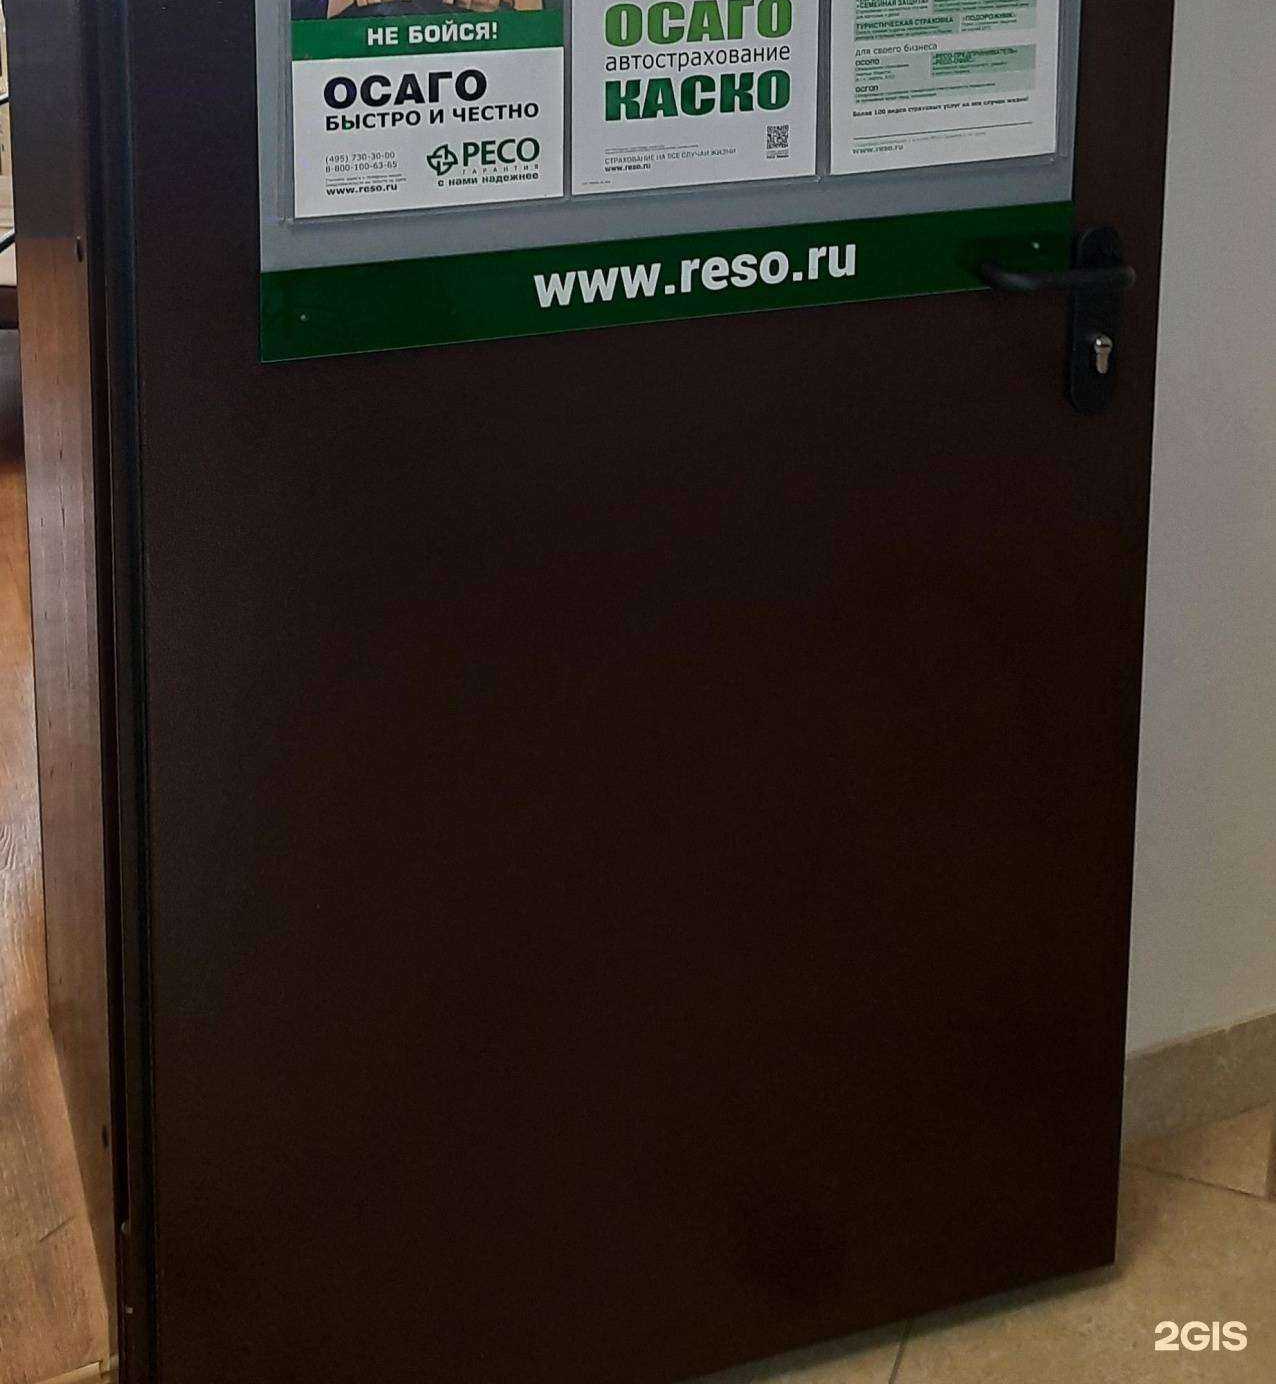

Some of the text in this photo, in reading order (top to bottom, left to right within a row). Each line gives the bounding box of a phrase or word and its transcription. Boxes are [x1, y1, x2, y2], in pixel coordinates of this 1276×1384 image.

[367, 20, 499, 46] НЕ БОЙСЯ!
[605, 41, 791, 72] автострахование
[323, 69, 488, 109] ОСАГО
[605, 69, 791, 121] КАСКО
[325, 102, 539, 131] БЫСТРО И ЧЕСТНО
[325, 154, 349, 164] (495)
[462, 137, 541, 167] РЕСО
[326, 183, 398, 196] www.reso.ru
[437, 171, 540, 187] с нами надежнее
[533, 244, 857, 308] www.reso.ru
